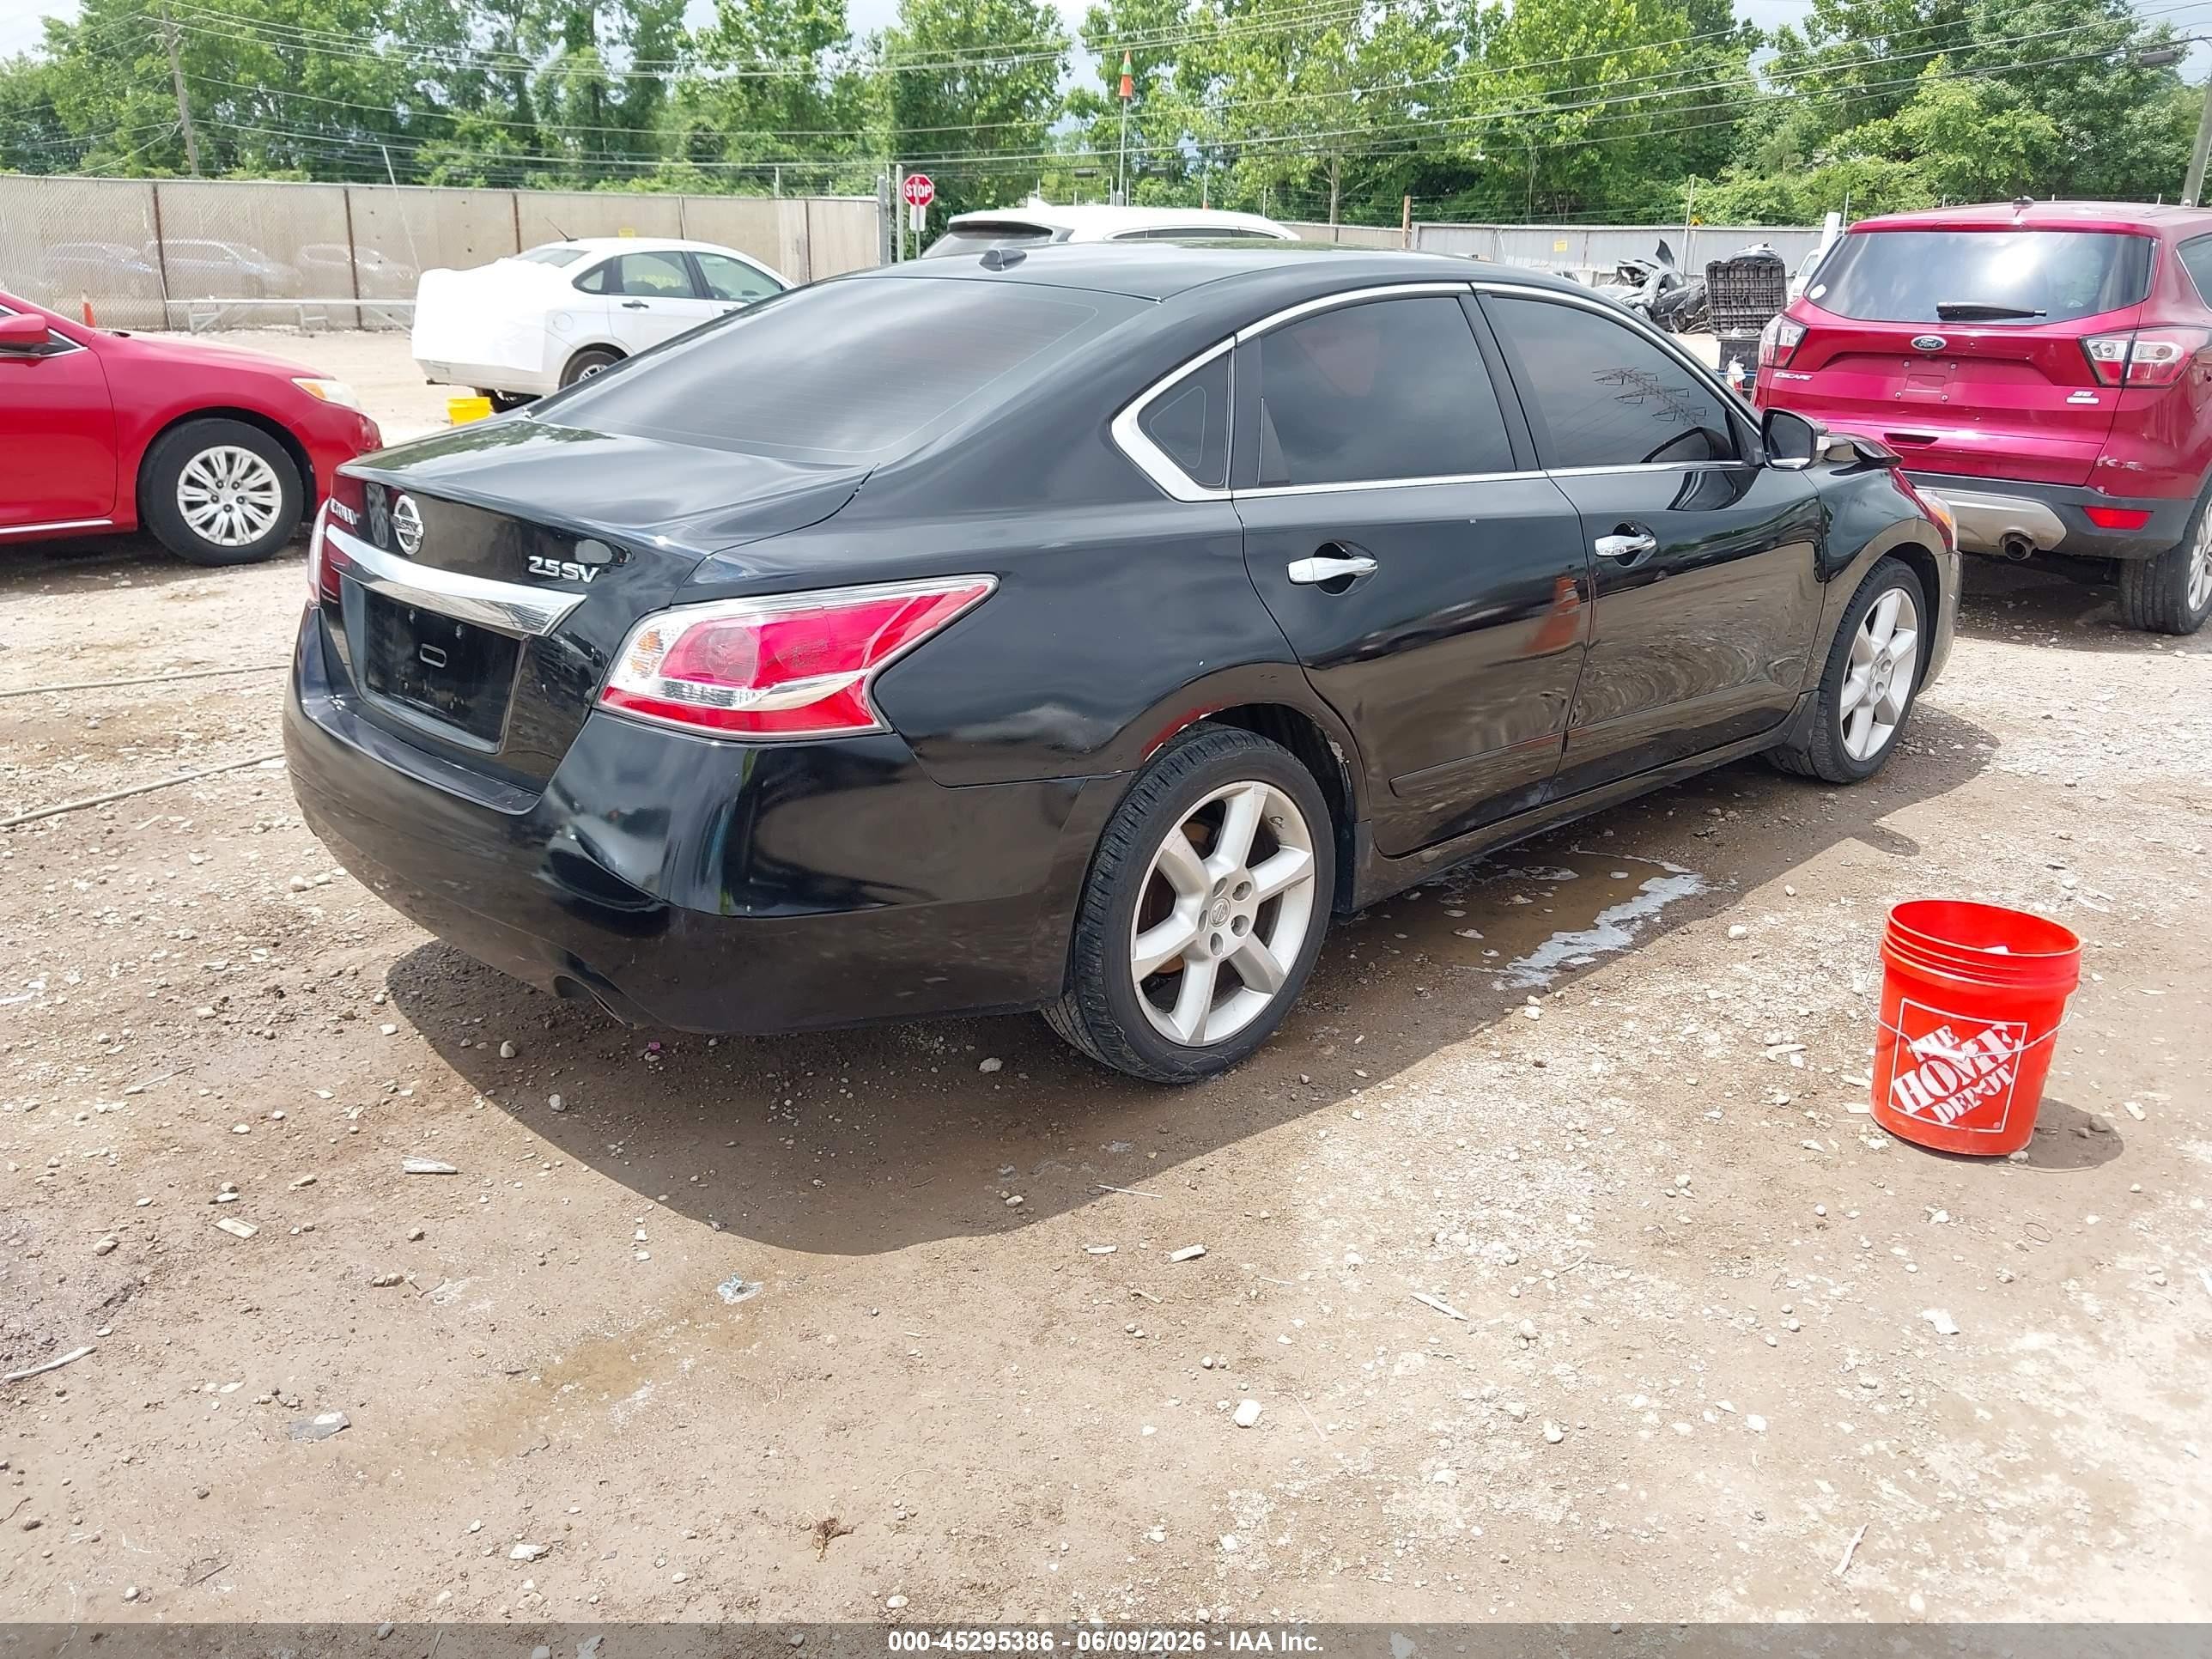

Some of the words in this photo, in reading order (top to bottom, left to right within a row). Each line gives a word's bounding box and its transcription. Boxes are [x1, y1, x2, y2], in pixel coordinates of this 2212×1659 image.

[906, 184, 932, 198] STOP
[1774, 372, 1814, 380] ESCAPE
[1893, 1023, 2021, 1115] HOME
[1930, 1064, 2014, 1124] DEPOT
